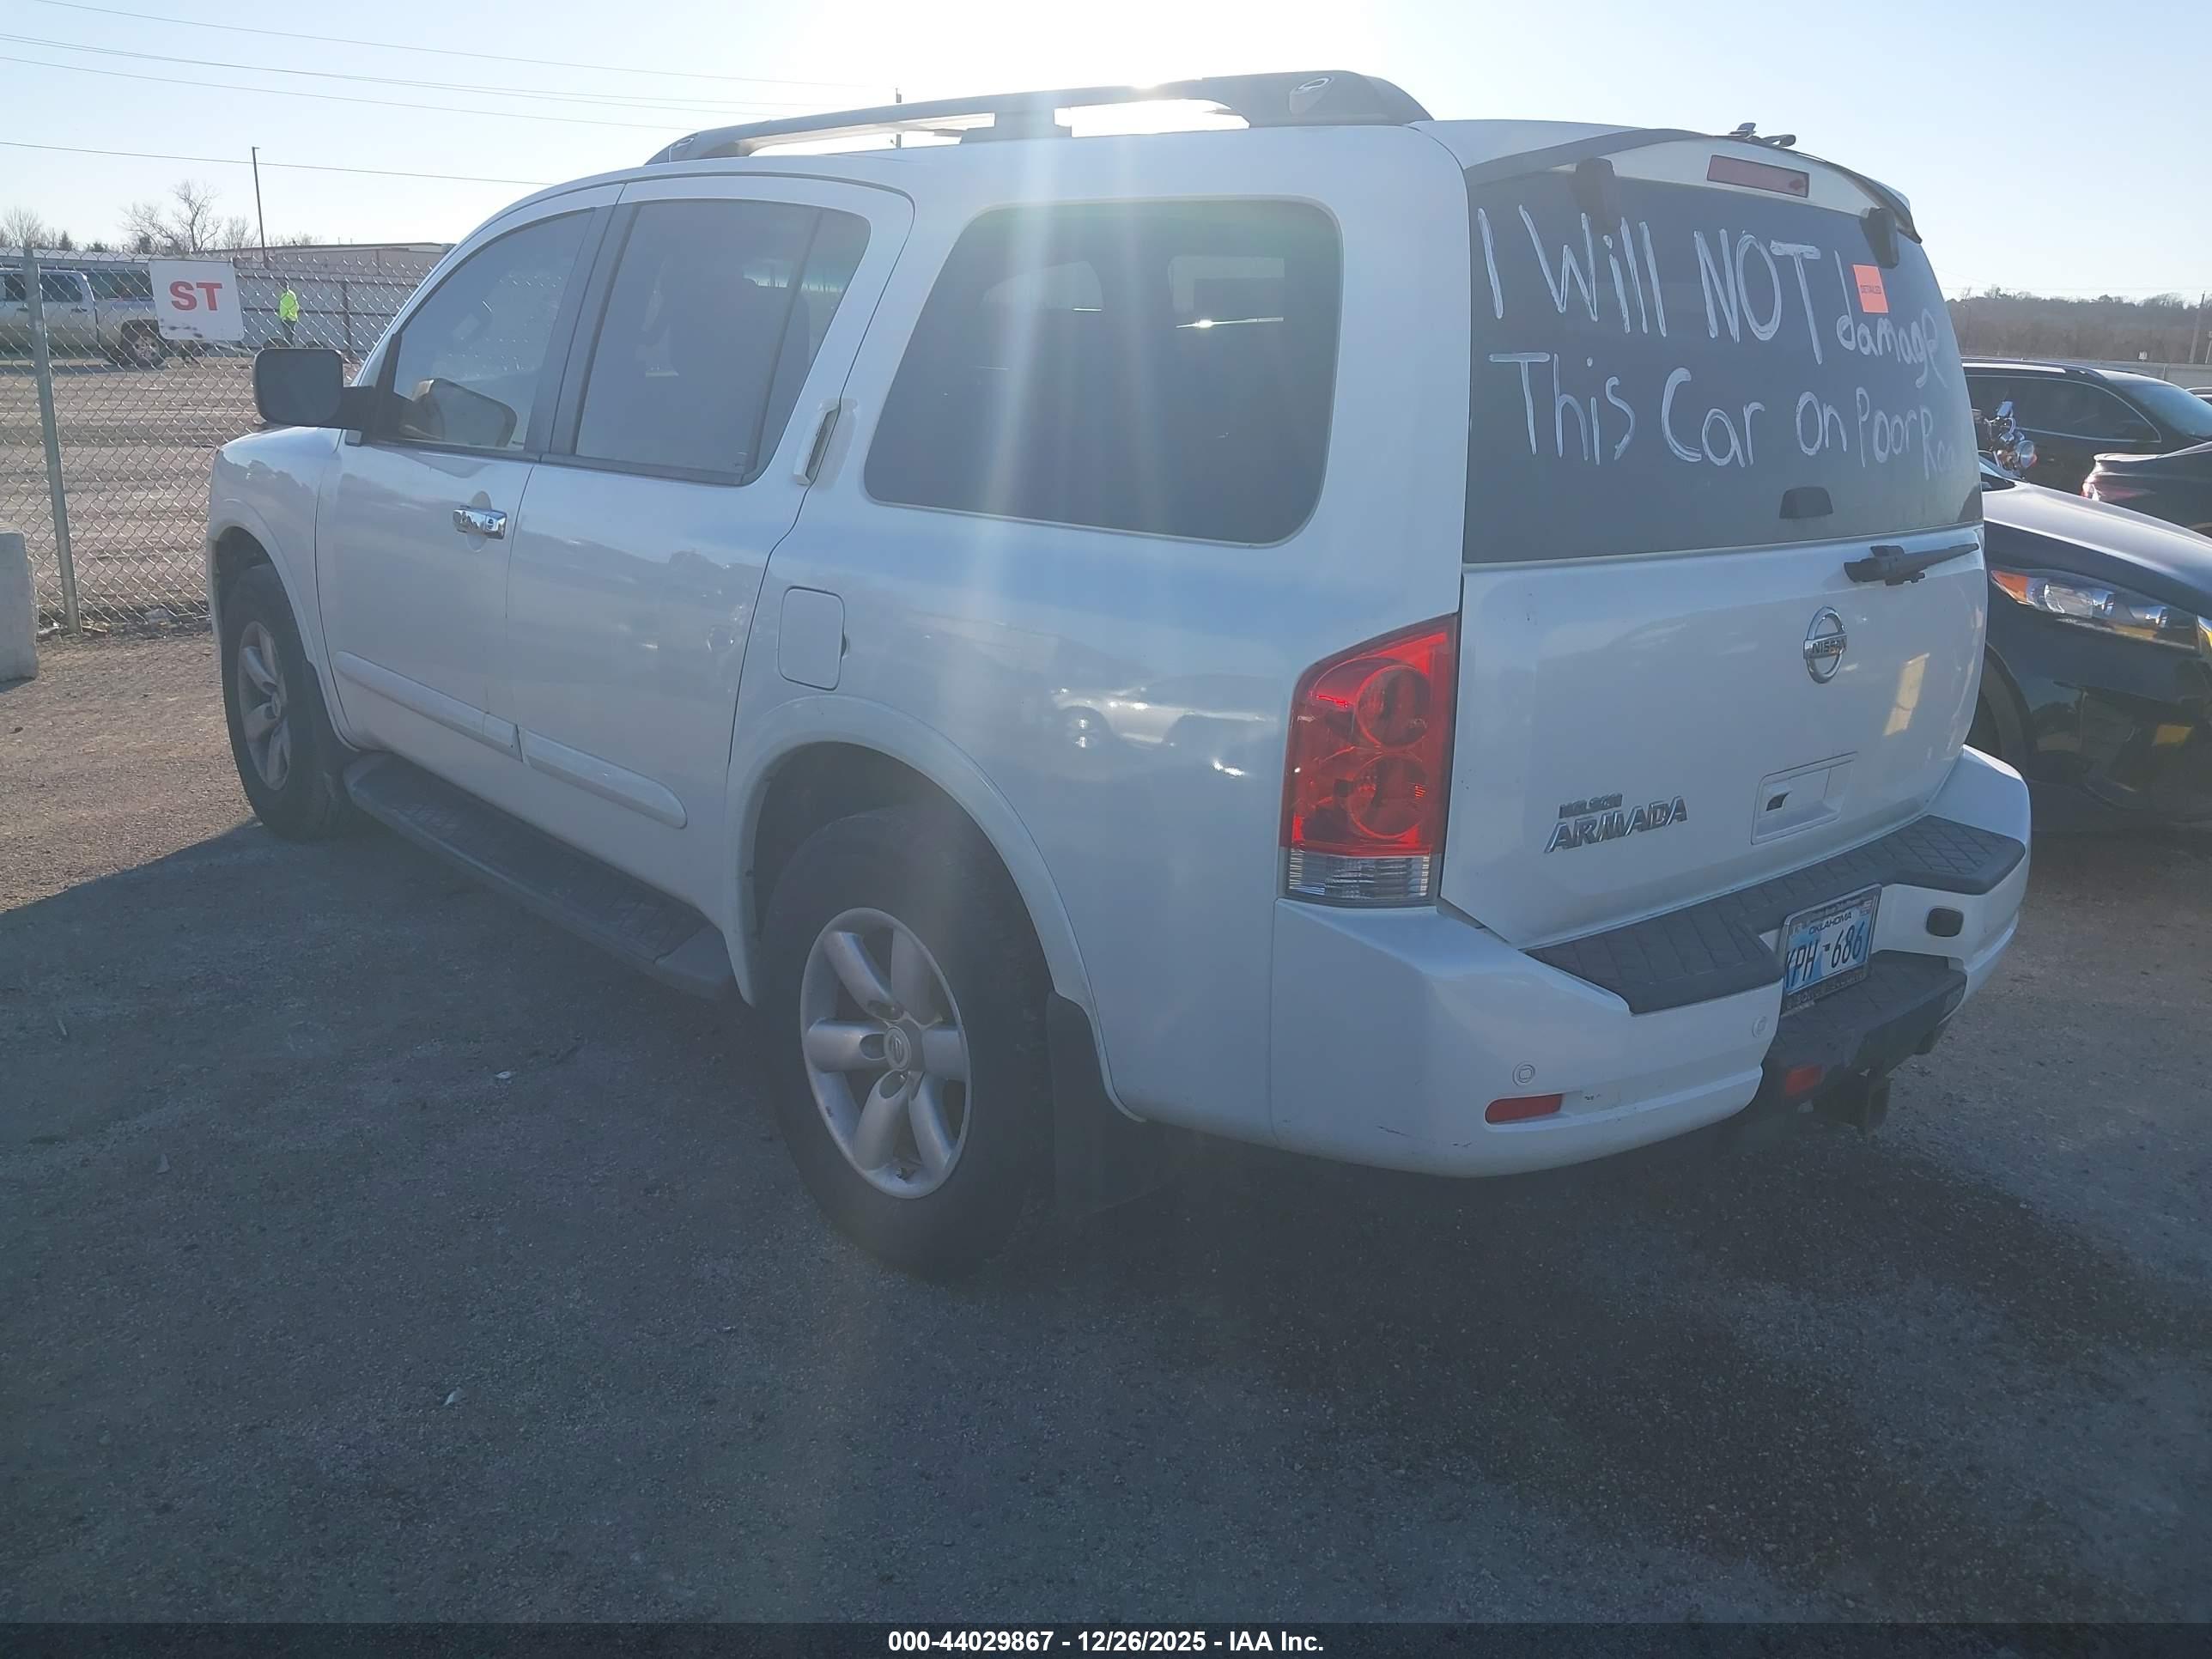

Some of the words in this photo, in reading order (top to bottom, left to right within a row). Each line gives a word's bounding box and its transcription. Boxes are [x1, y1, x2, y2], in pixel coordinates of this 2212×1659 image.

[169, 281, 222, 311] ST
[1477, 207, 1504, 319] I
[1519, 204, 1667, 337] Will
[1693, 228, 1822, 365] NOT
[1836, 250, 1948, 388] damage
[1489, 352, 1636, 465] This
[1662, 367, 1765, 468] Car
[1856, 386, 1917, 468] Poor
[1812, 635, 1846, 653] NISSAN
[1544, 795, 1688, 854] ARMADA
[1808, 911, 1852, 935] OKLAHOMA
